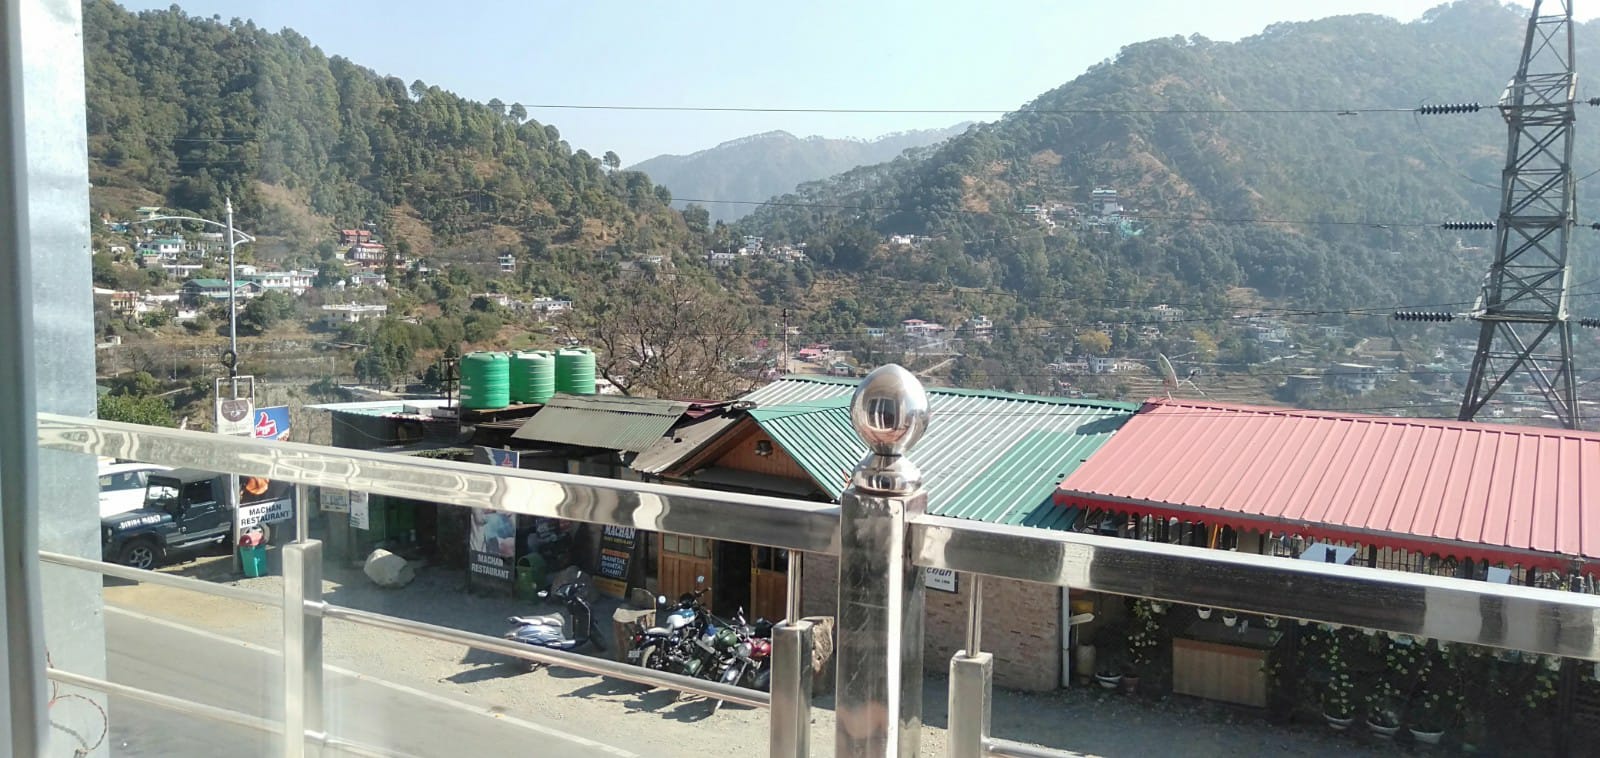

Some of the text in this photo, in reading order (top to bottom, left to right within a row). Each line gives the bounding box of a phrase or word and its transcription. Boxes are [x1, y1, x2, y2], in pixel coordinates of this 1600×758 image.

[249, 504, 282, 516] MACHAN
[241, 511, 289, 526] RESTAURANT
[604, 525, 636, 539] MACHAN
[477, 554, 504, 567] MACHAN
[471, 563, 510, 579] RESTAURANT
